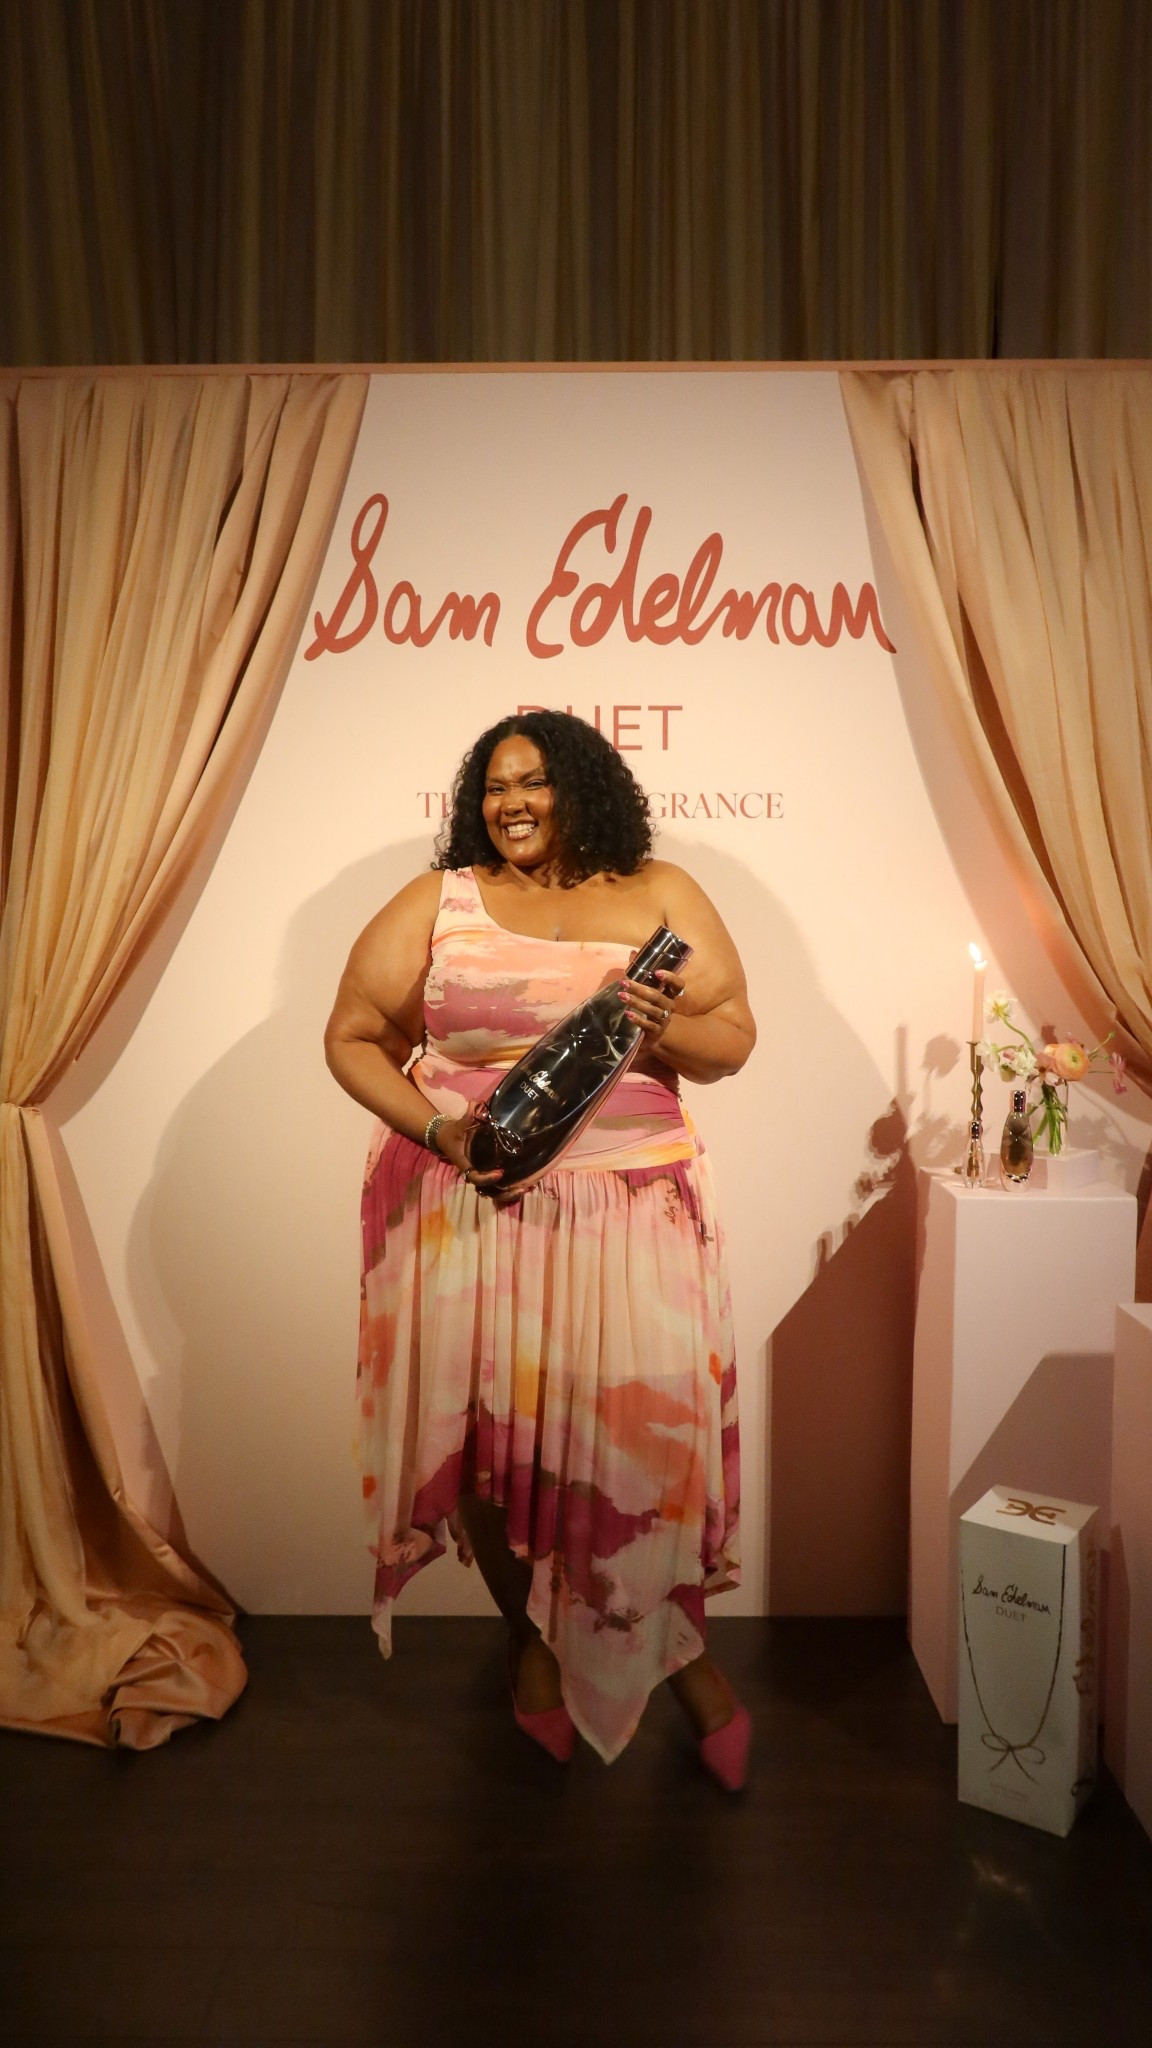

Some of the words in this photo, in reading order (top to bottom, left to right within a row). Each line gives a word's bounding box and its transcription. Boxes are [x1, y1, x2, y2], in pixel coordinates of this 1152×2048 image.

[304, 493, 500, 661] Sam
[526, 493, 897, 659] Edelman
[516, 705, 683, 751] ET
[646, 792, 785, 819] GRANCE
[520, 1081, 540, 1101] DUET
[972, 1574, 999, 1599] Sam
[1001, 1583, 1051, 1616] Edelman
[996, 1605, 1027, 1622] DUET
